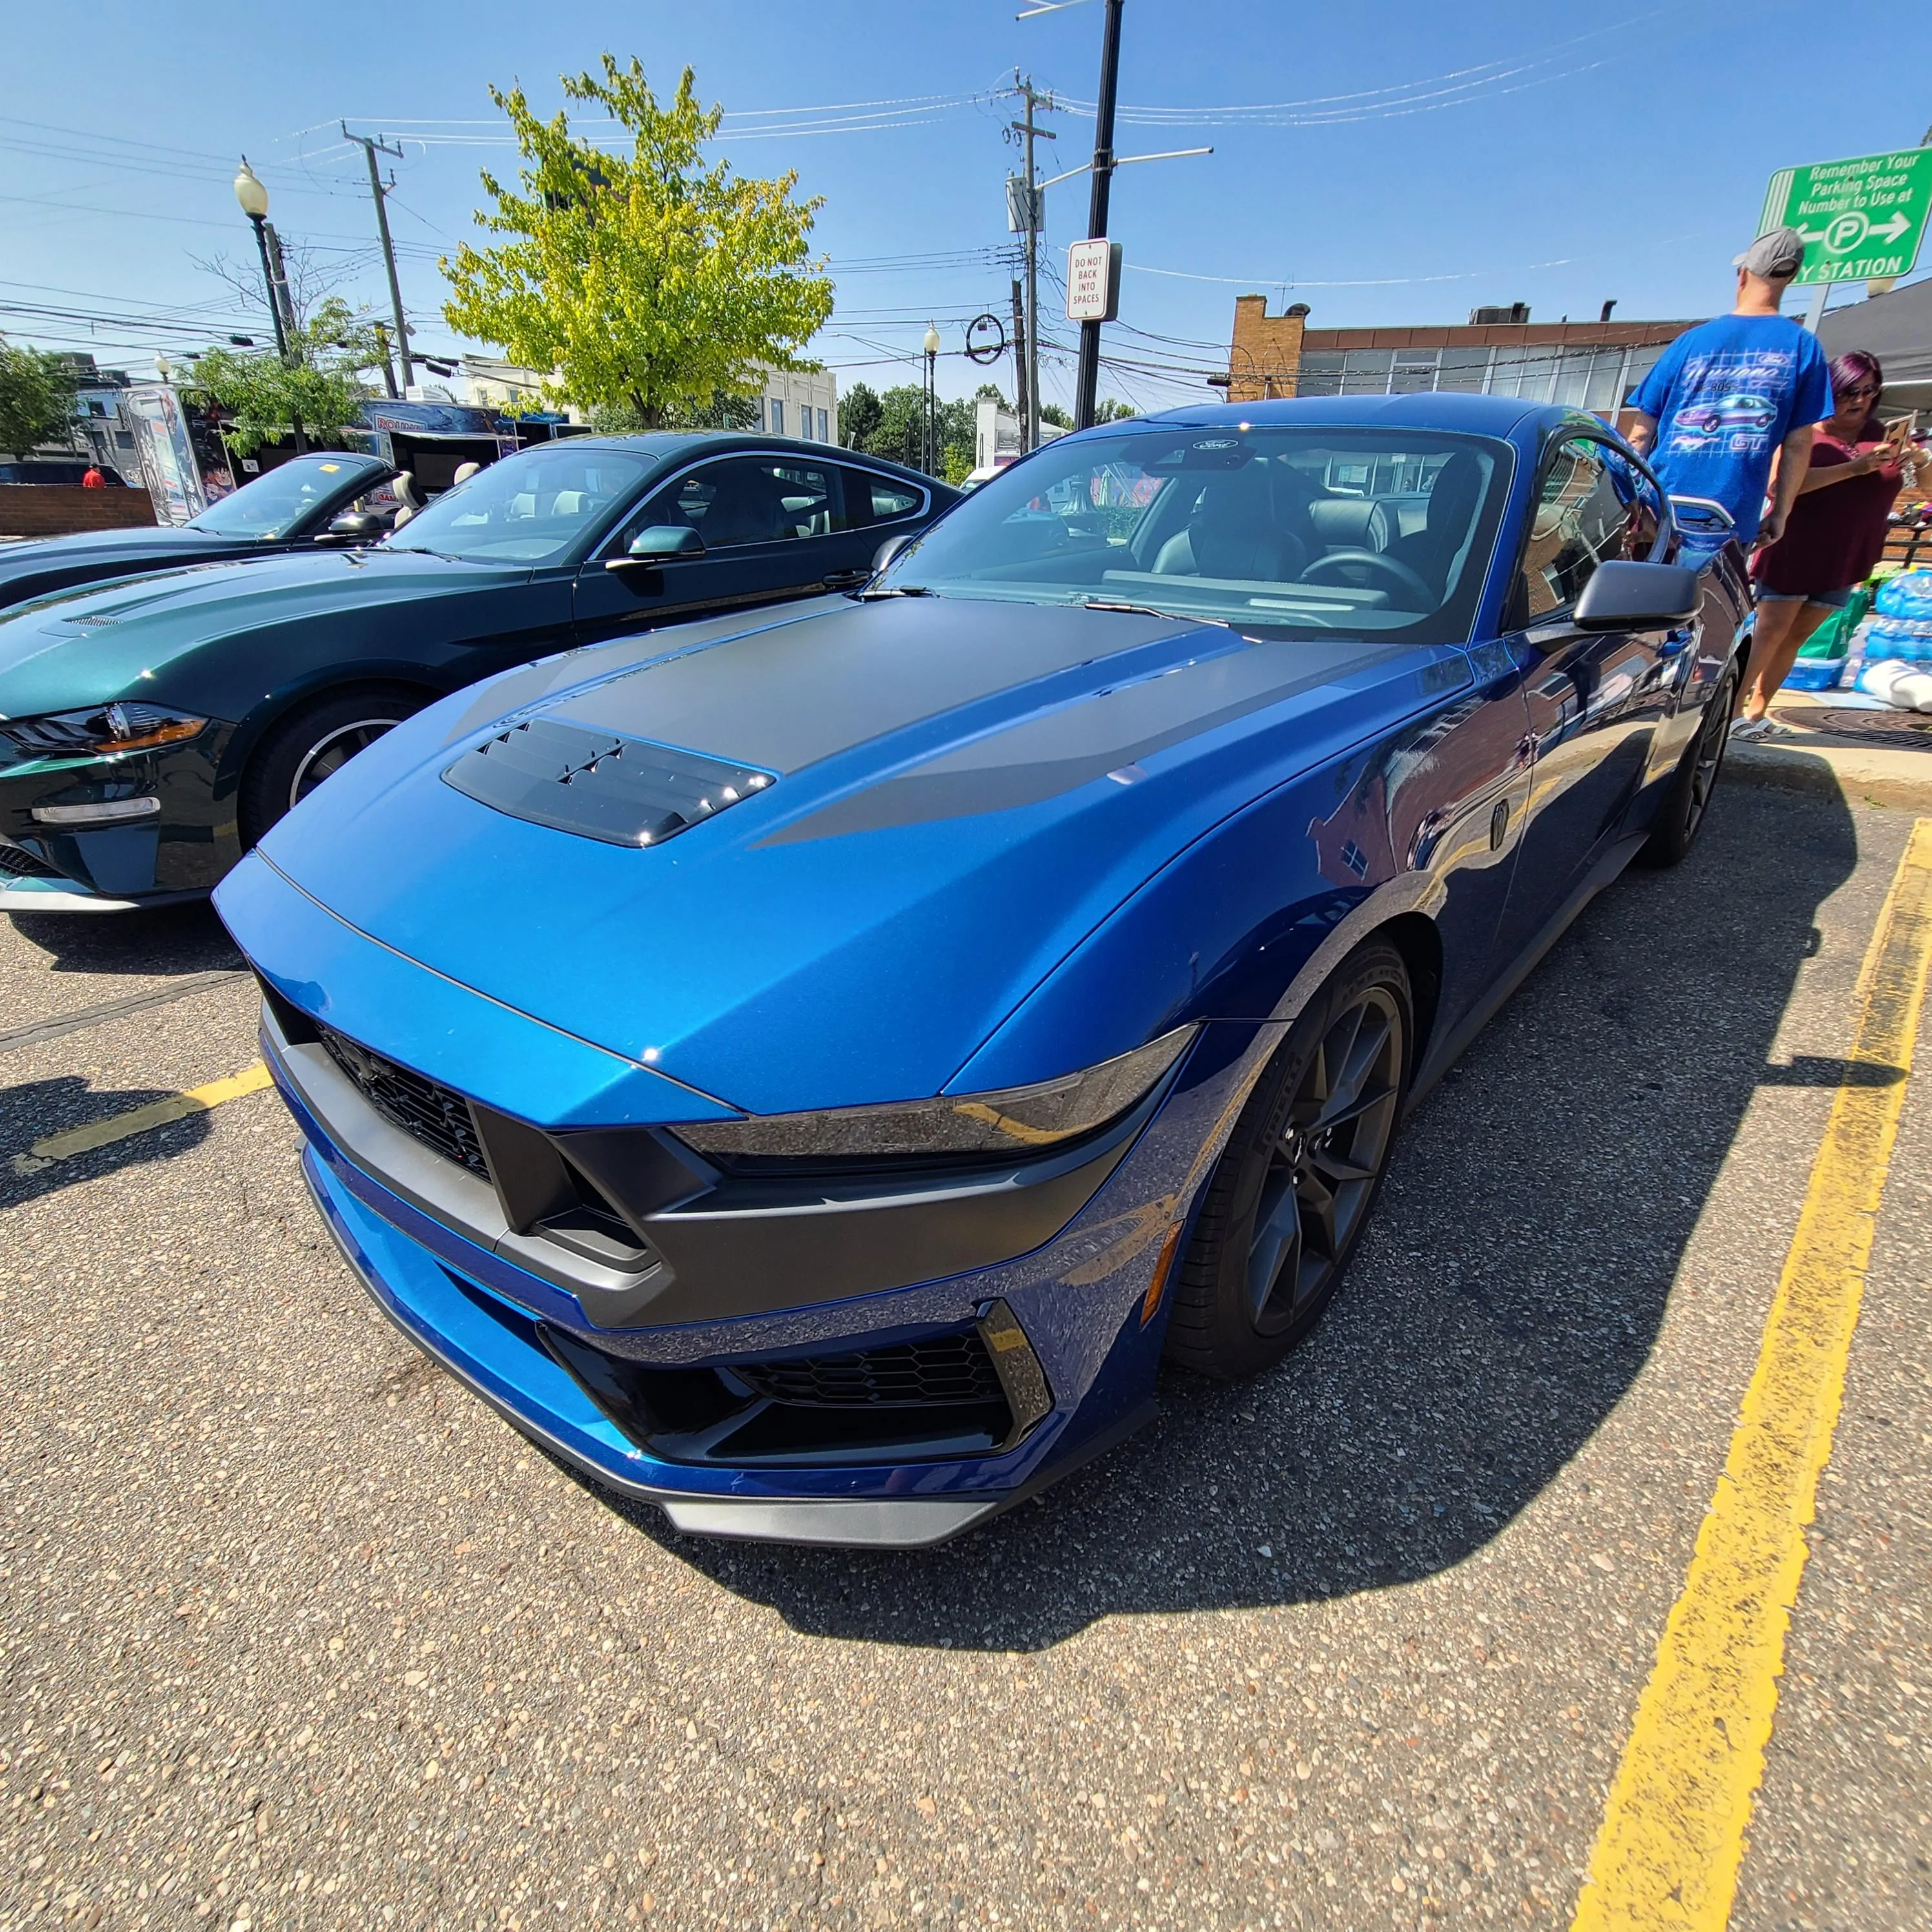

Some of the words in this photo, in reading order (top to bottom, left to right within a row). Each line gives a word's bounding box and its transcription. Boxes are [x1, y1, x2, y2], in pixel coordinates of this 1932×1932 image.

[1810, 159, 1882, 180] Remember
[1887, 154, 1920, 169] Your
[1811, 177, 1862, 197] Parking
[1866, 174, 1908, 190] Space
[1798, 197, 1850, 215] Number
[1854, 194, 1867, 208] to
[1871, 191, 1894, 207] Use
[1898, 187, 1913, 201] at
[1075, 258, 1085, 267] DO
[1087, 256, 1102, 266] NOT
[1818, 256, 1902, 279] STATION
[1078, 269, 1097, 280] BACK
[1078, 282, 1095, 291] INTO
[1073, 294, 1099, 304] SPACES
[1197, 440, 1233, 449] Ford
[1730, 433, 1769, 450] GT
